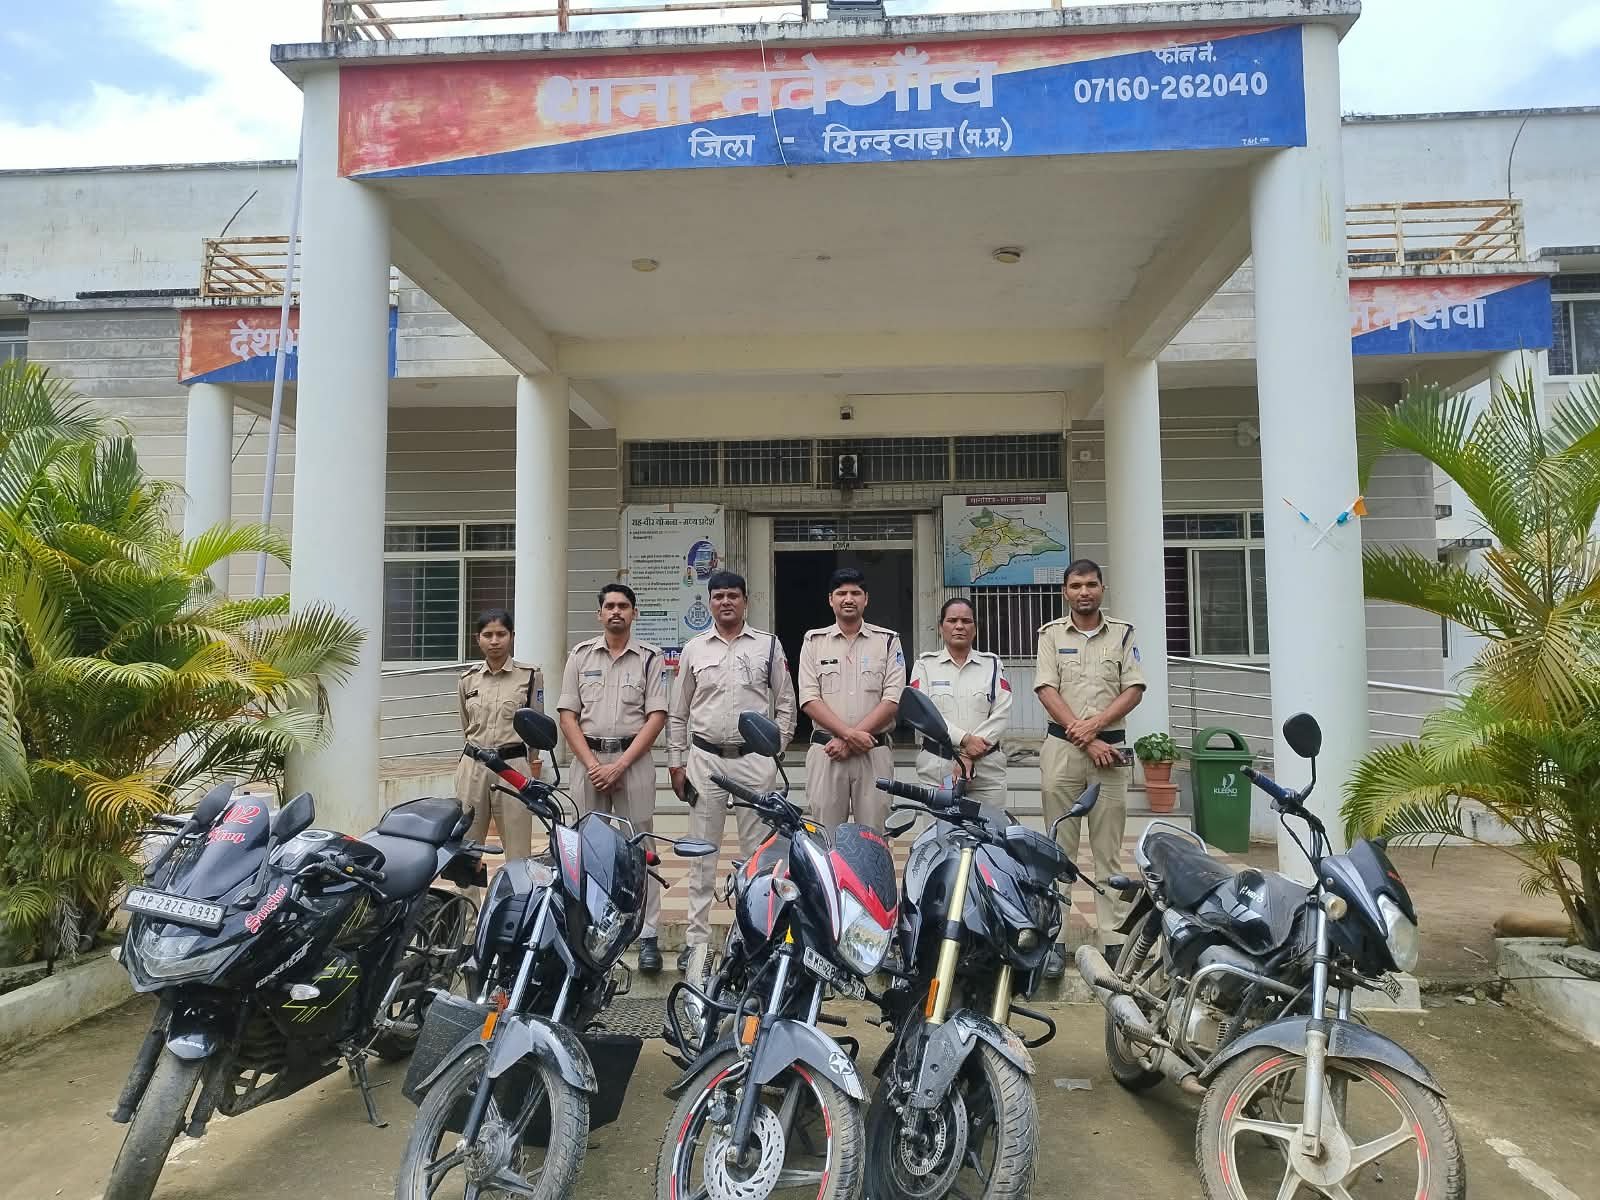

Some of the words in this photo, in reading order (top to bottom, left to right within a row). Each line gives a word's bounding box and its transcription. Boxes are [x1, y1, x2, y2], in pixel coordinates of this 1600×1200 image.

[541, 75, 698, 125] थाना
[1074, 71, 1268, 104] 07160-262040
[688, 127, 755, 161] जिला
[822, 123, 955, 156] छिन्दवाड़ा
[1414, 289, 1487, 330] सेवा
[138, 894, 154, 907] MP
